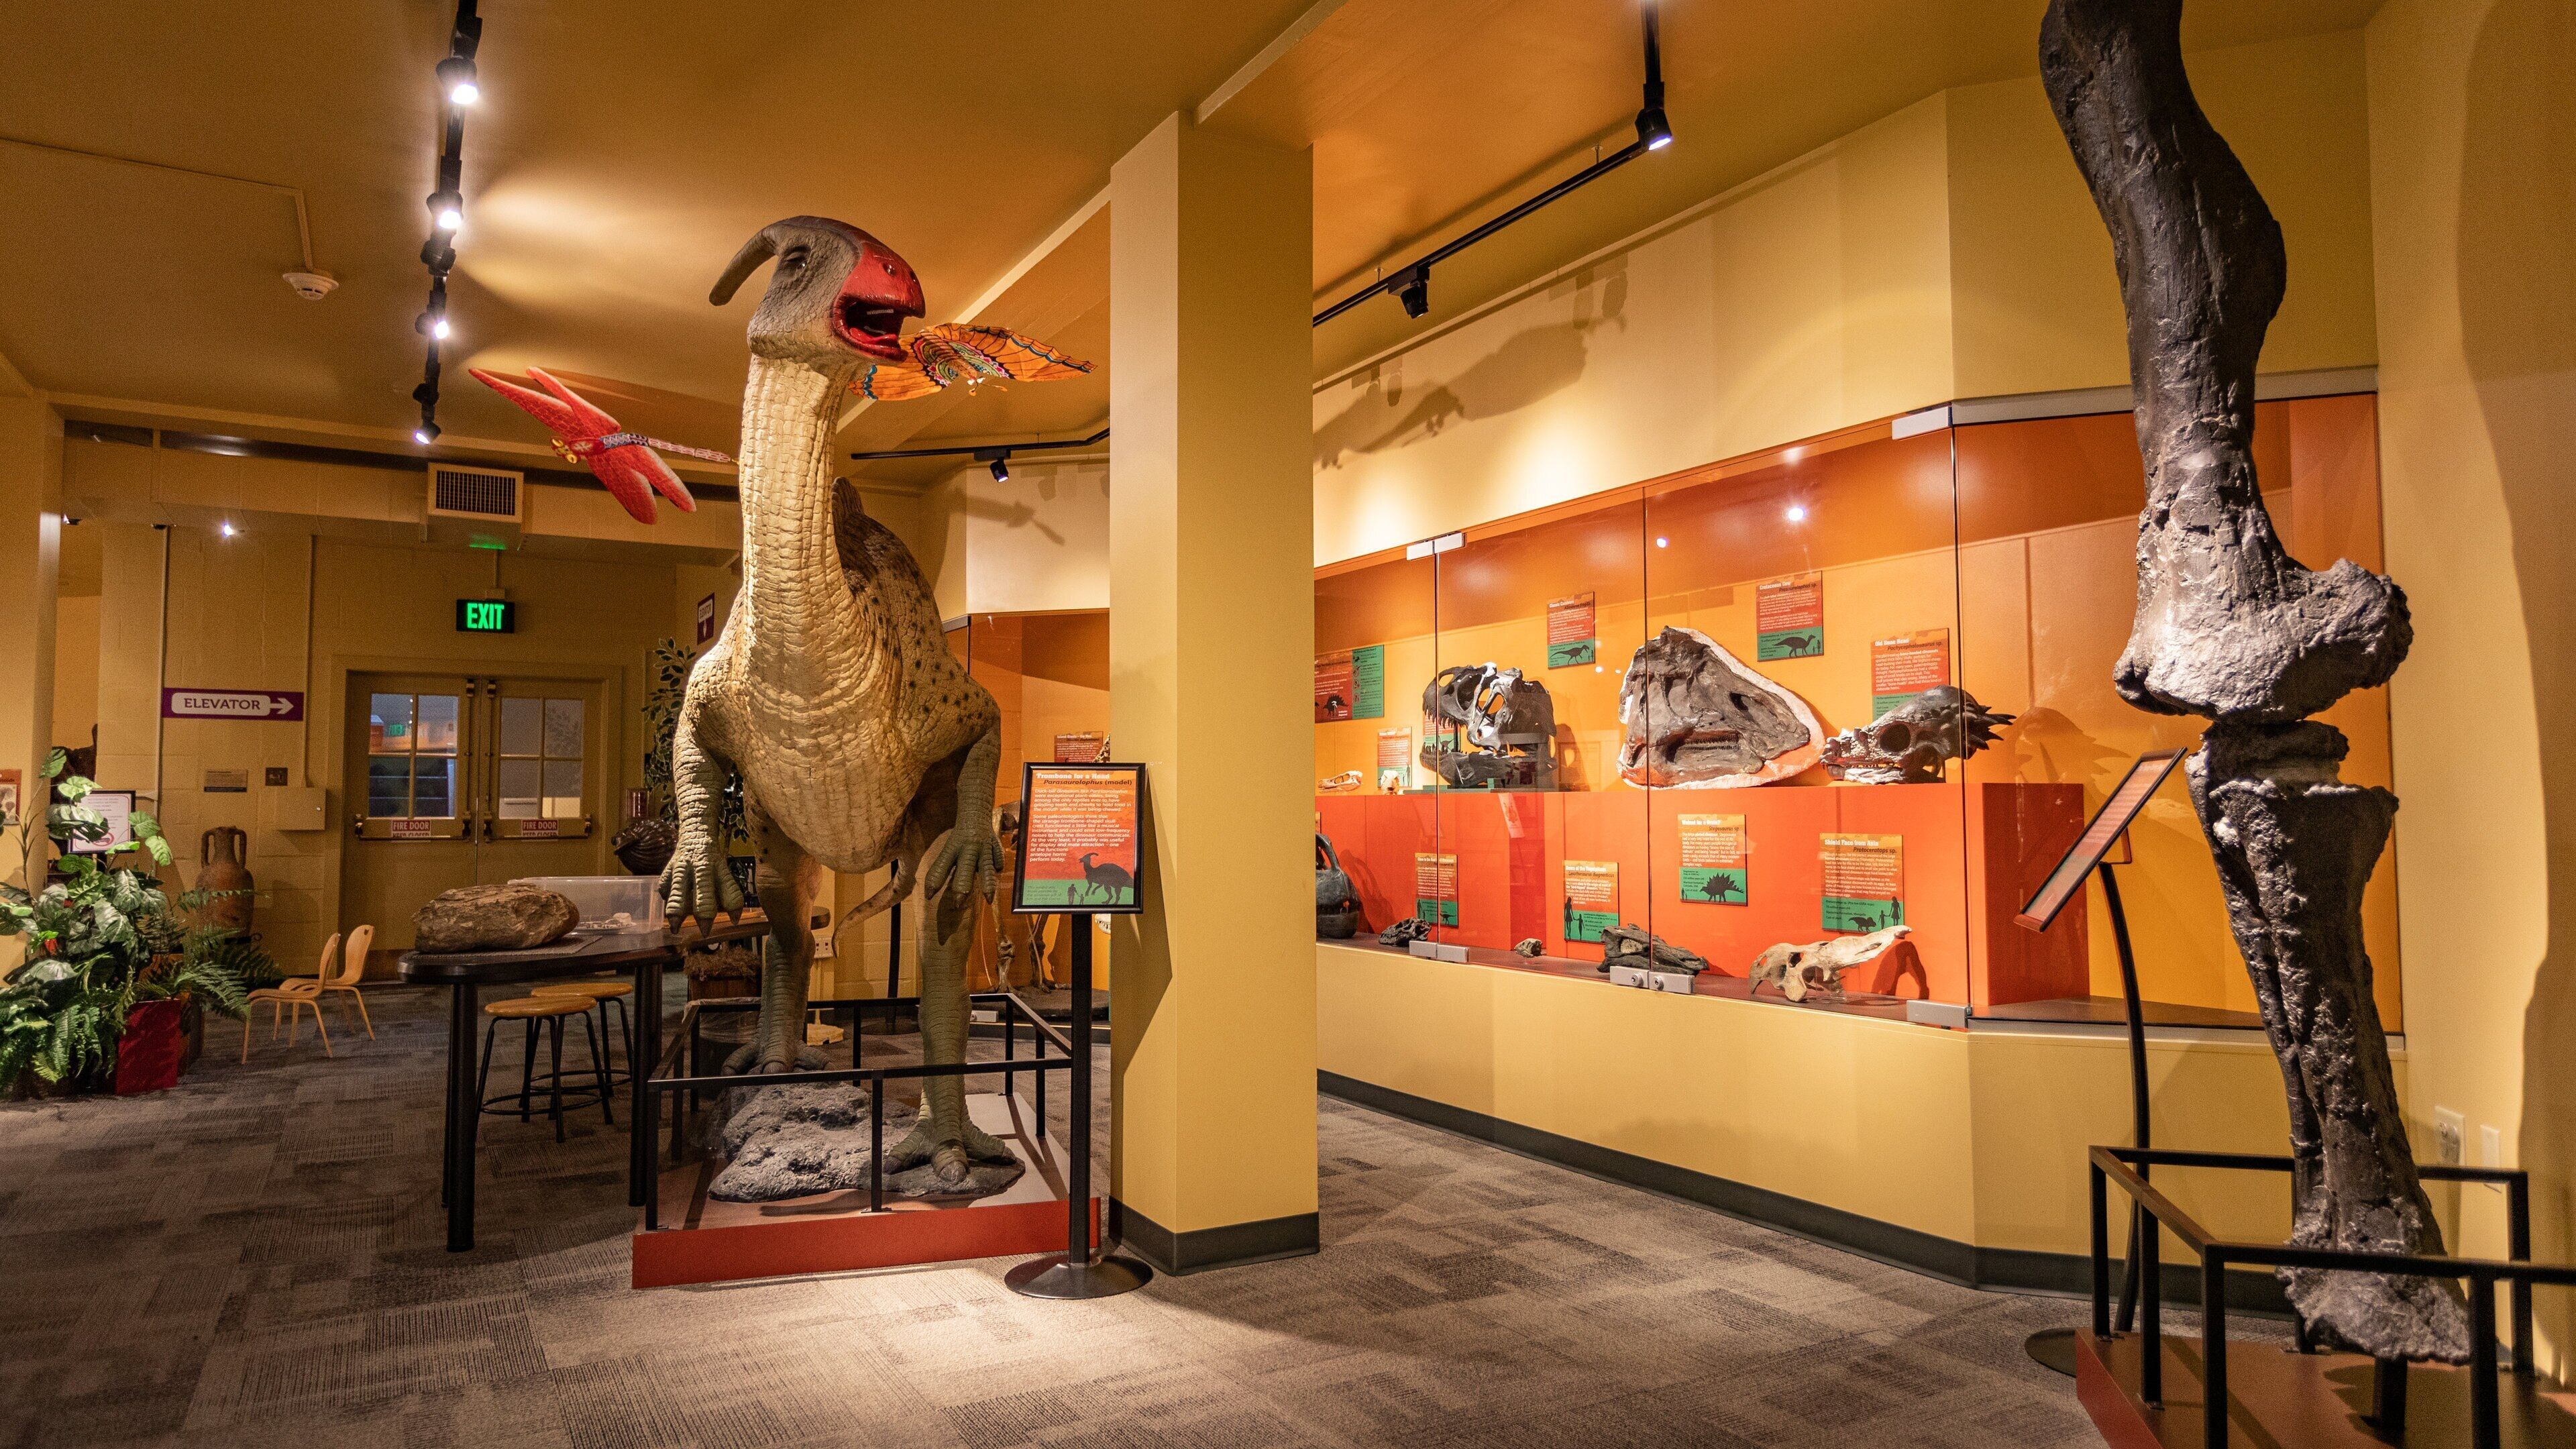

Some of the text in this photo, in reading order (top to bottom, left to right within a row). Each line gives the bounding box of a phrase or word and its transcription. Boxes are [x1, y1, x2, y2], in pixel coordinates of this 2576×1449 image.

[467, 602, 505, 629] EXIT
[184, 698, 260, 710] ELEVATOR
[393, 822, 429, 830] FIRE DOOR
[523, 821, 557, 830] FIRE DOOR
